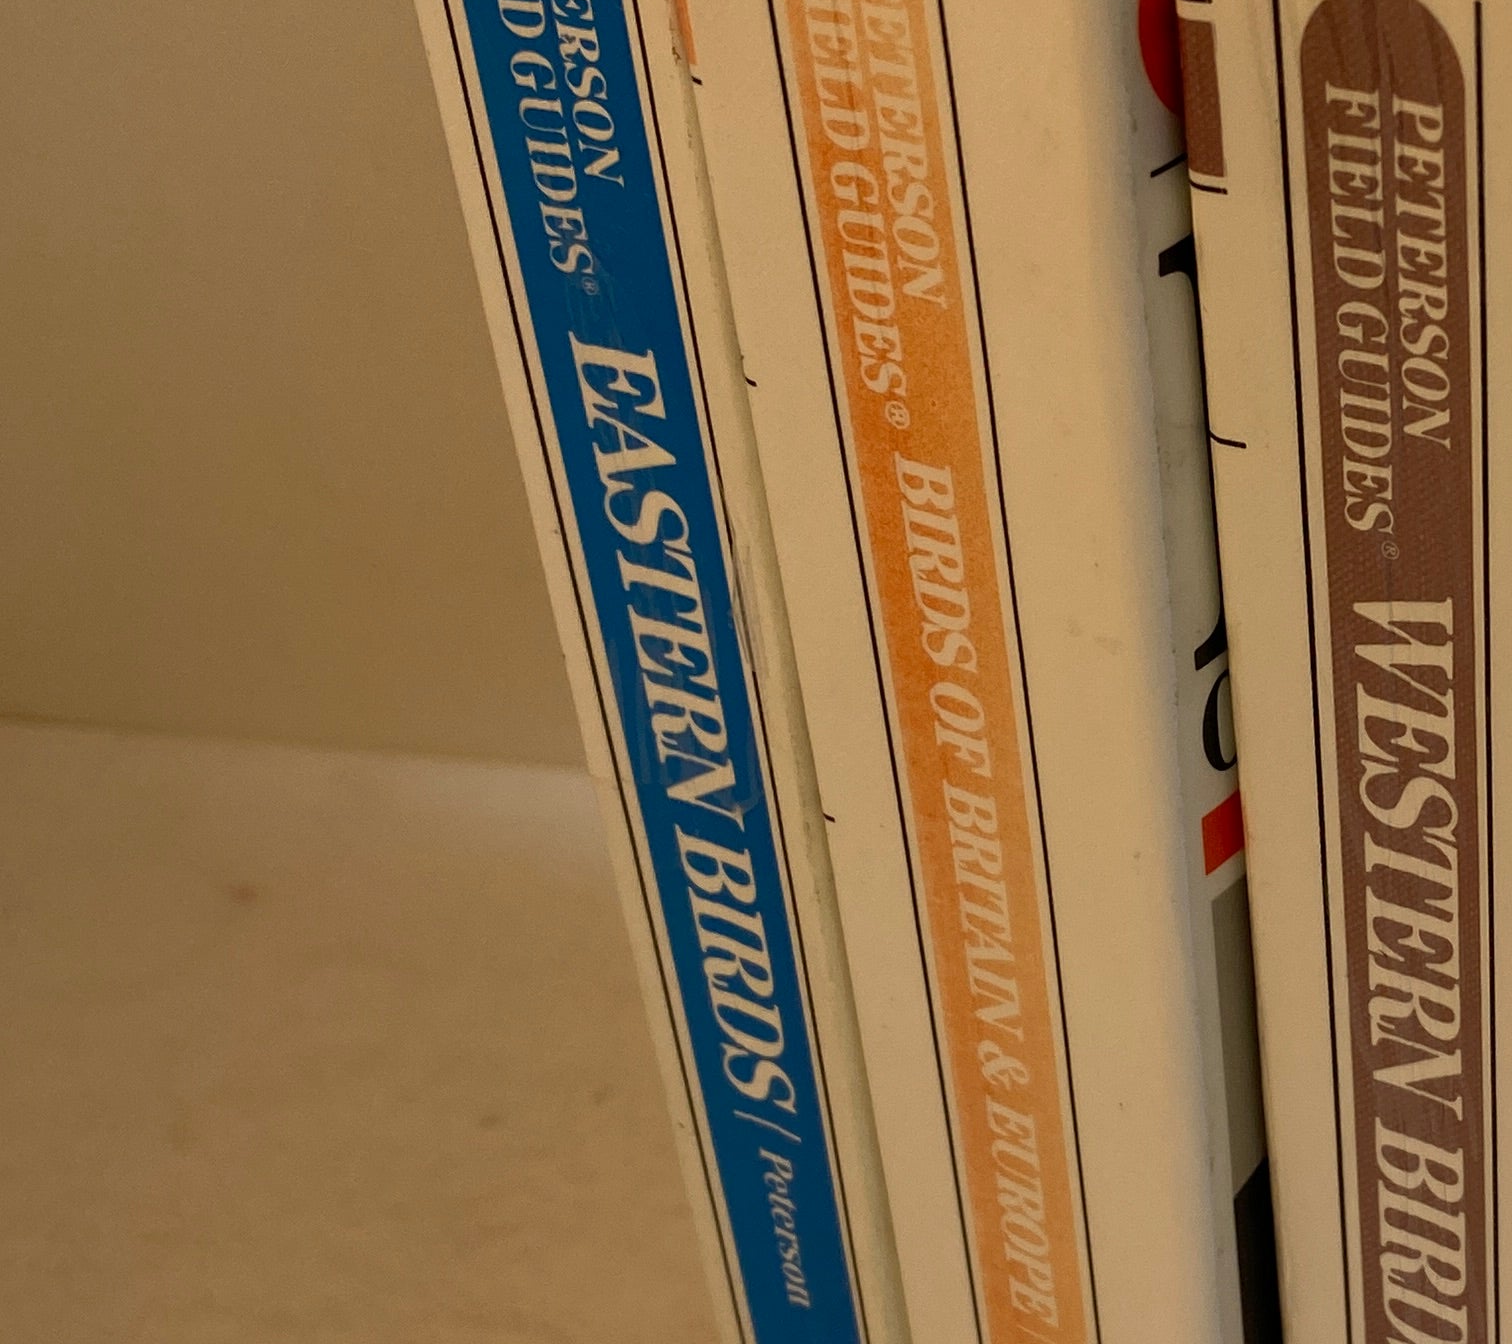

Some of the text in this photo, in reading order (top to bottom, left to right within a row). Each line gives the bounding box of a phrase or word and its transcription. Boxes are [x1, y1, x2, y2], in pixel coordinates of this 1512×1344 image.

[1325, 83, 1387, 290] FIELD
[1392, 92, 1452, 450] PETERSON
[894, 451, 977, 675] BIRDS
[569, 331, 745, 835] EASTERN
[759, 1147, 811, 1308] Peterson
[928, 680, 994, 782] OF
[943, 777, 1025, 1042] BRITAIN
[1352, 596, 1464, 1122] WESTERN
[977, 1038, 1030, 1091] &
